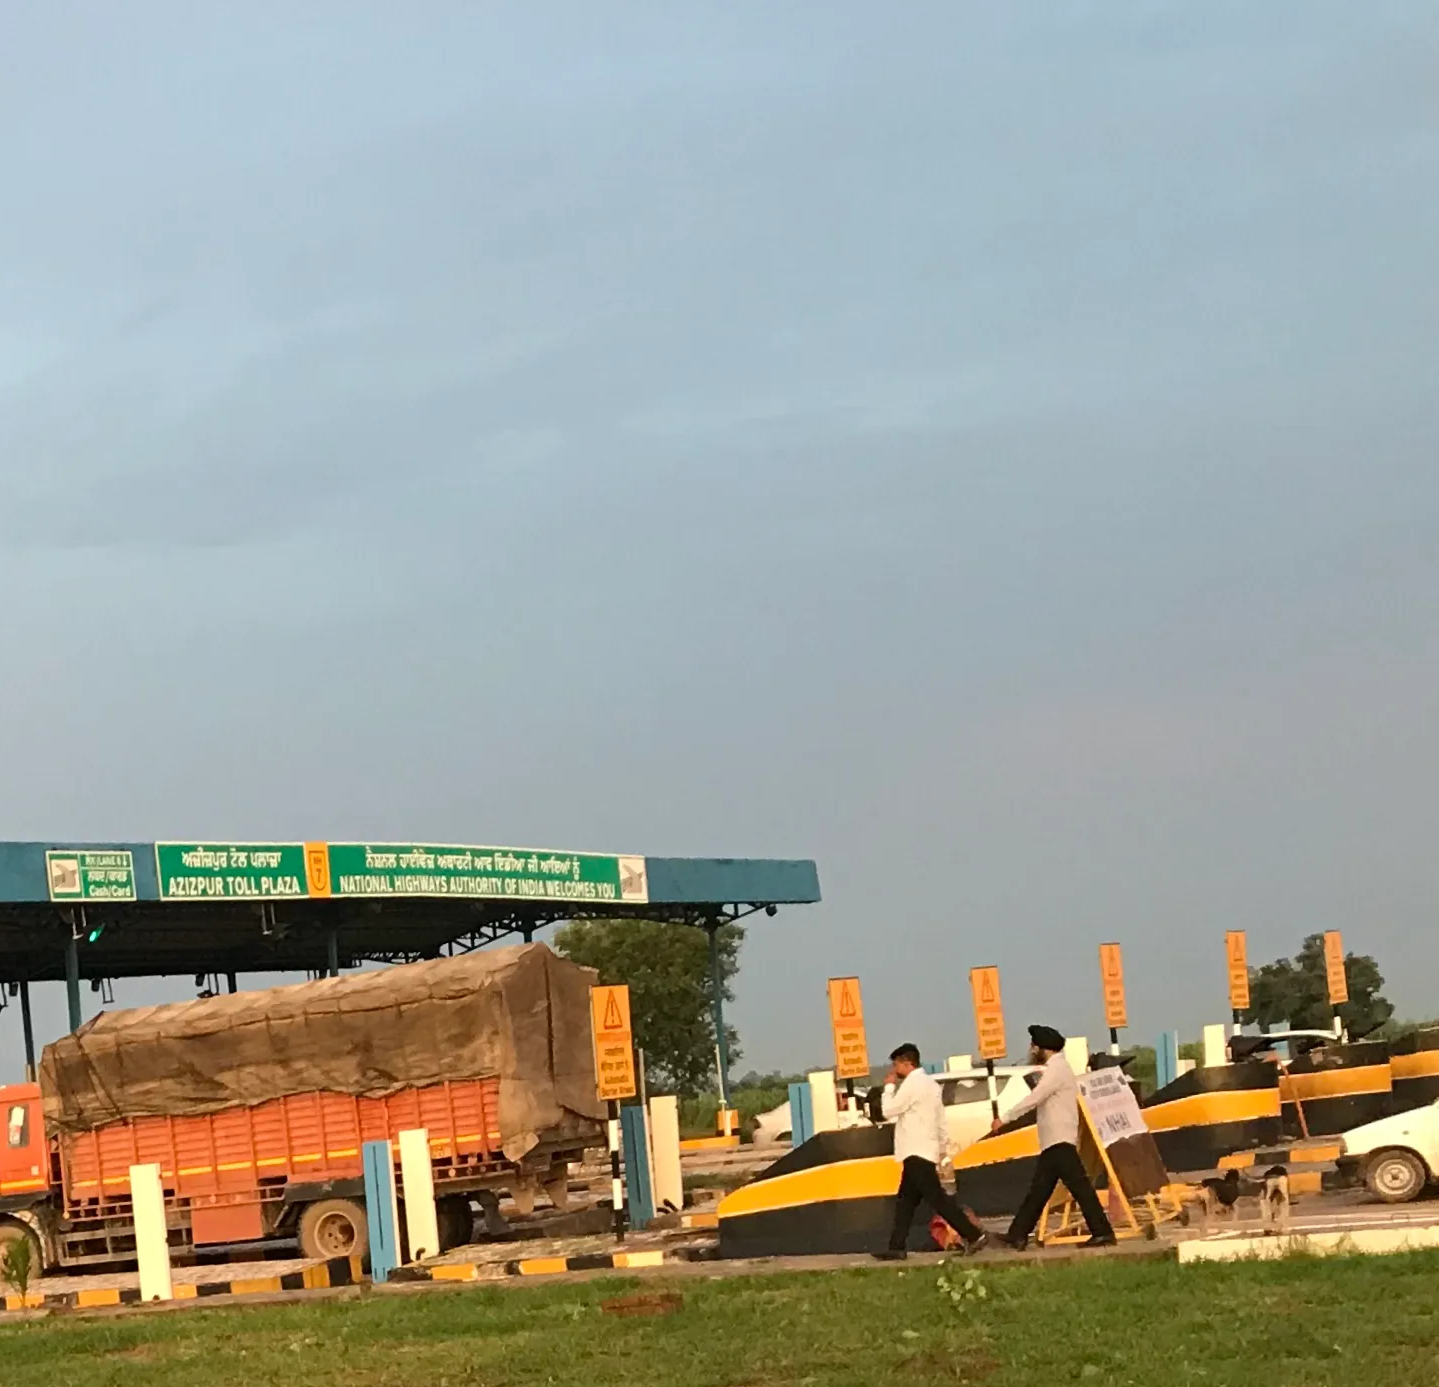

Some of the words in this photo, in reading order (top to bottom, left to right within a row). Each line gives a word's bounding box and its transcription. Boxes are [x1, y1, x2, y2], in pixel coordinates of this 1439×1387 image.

[168, 876, 224, 895] AZIZPUR
[226, 876, 259, 895] TOLL
[260, 875, 301, 895] PLAZA
[339, 874, 393, 893] NATIONAL
[394, 875, 448, 893] HIGHWAYS
[449, 876, 502, 894] AUTHORITY
[504, 877, 517, 894] OF
[518, 878, 545, 896] INDIA
[546, 879, 596, 897] WELCOMES
[596, 882, 616, 898] YOU
